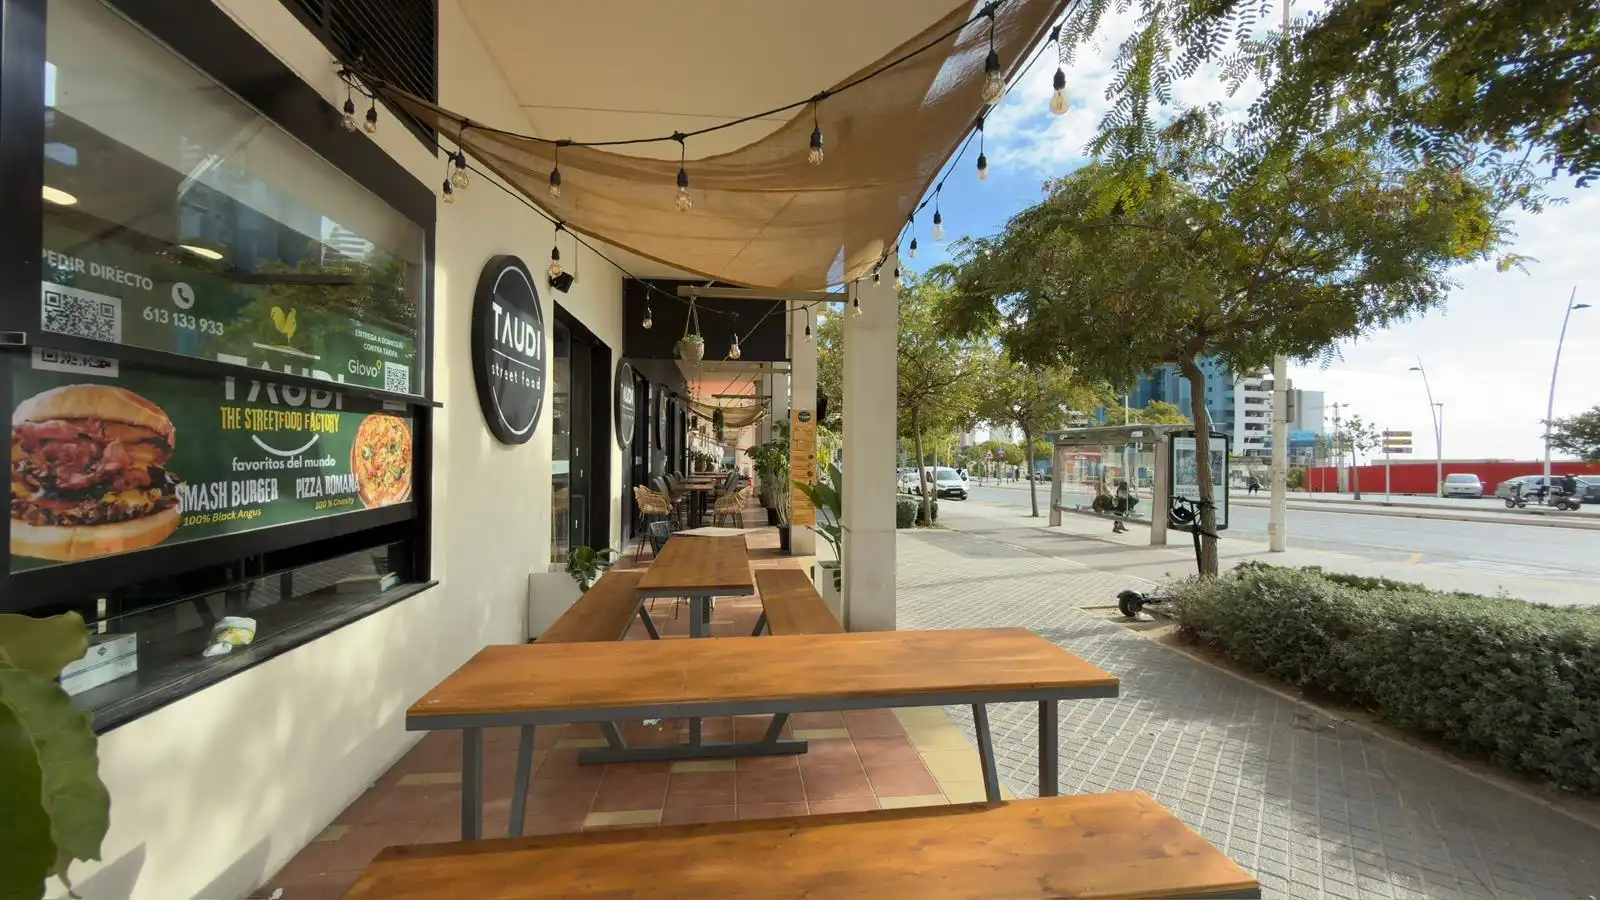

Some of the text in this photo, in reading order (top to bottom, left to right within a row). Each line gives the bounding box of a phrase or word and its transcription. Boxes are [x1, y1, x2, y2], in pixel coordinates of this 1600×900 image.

[90, 262, 153, 290] DIRECTO
[143, 306, 224, 336] 613 133 933
[491, 302, 541, 360] TAUDI
[348, 359, 378, 378] Glovo
[491, 362, 540, 390] street food
[220, 406, 340, 433] THE STREETFOOD FACTORY
[232, 454, 336, 472] favoritos del mundo
[175, 478, 279, 514] SMASH BURGER
[296, 474, 360, 499] PIZZA ROMANA
[184, 507, 262, 527] 100% Black Angus
